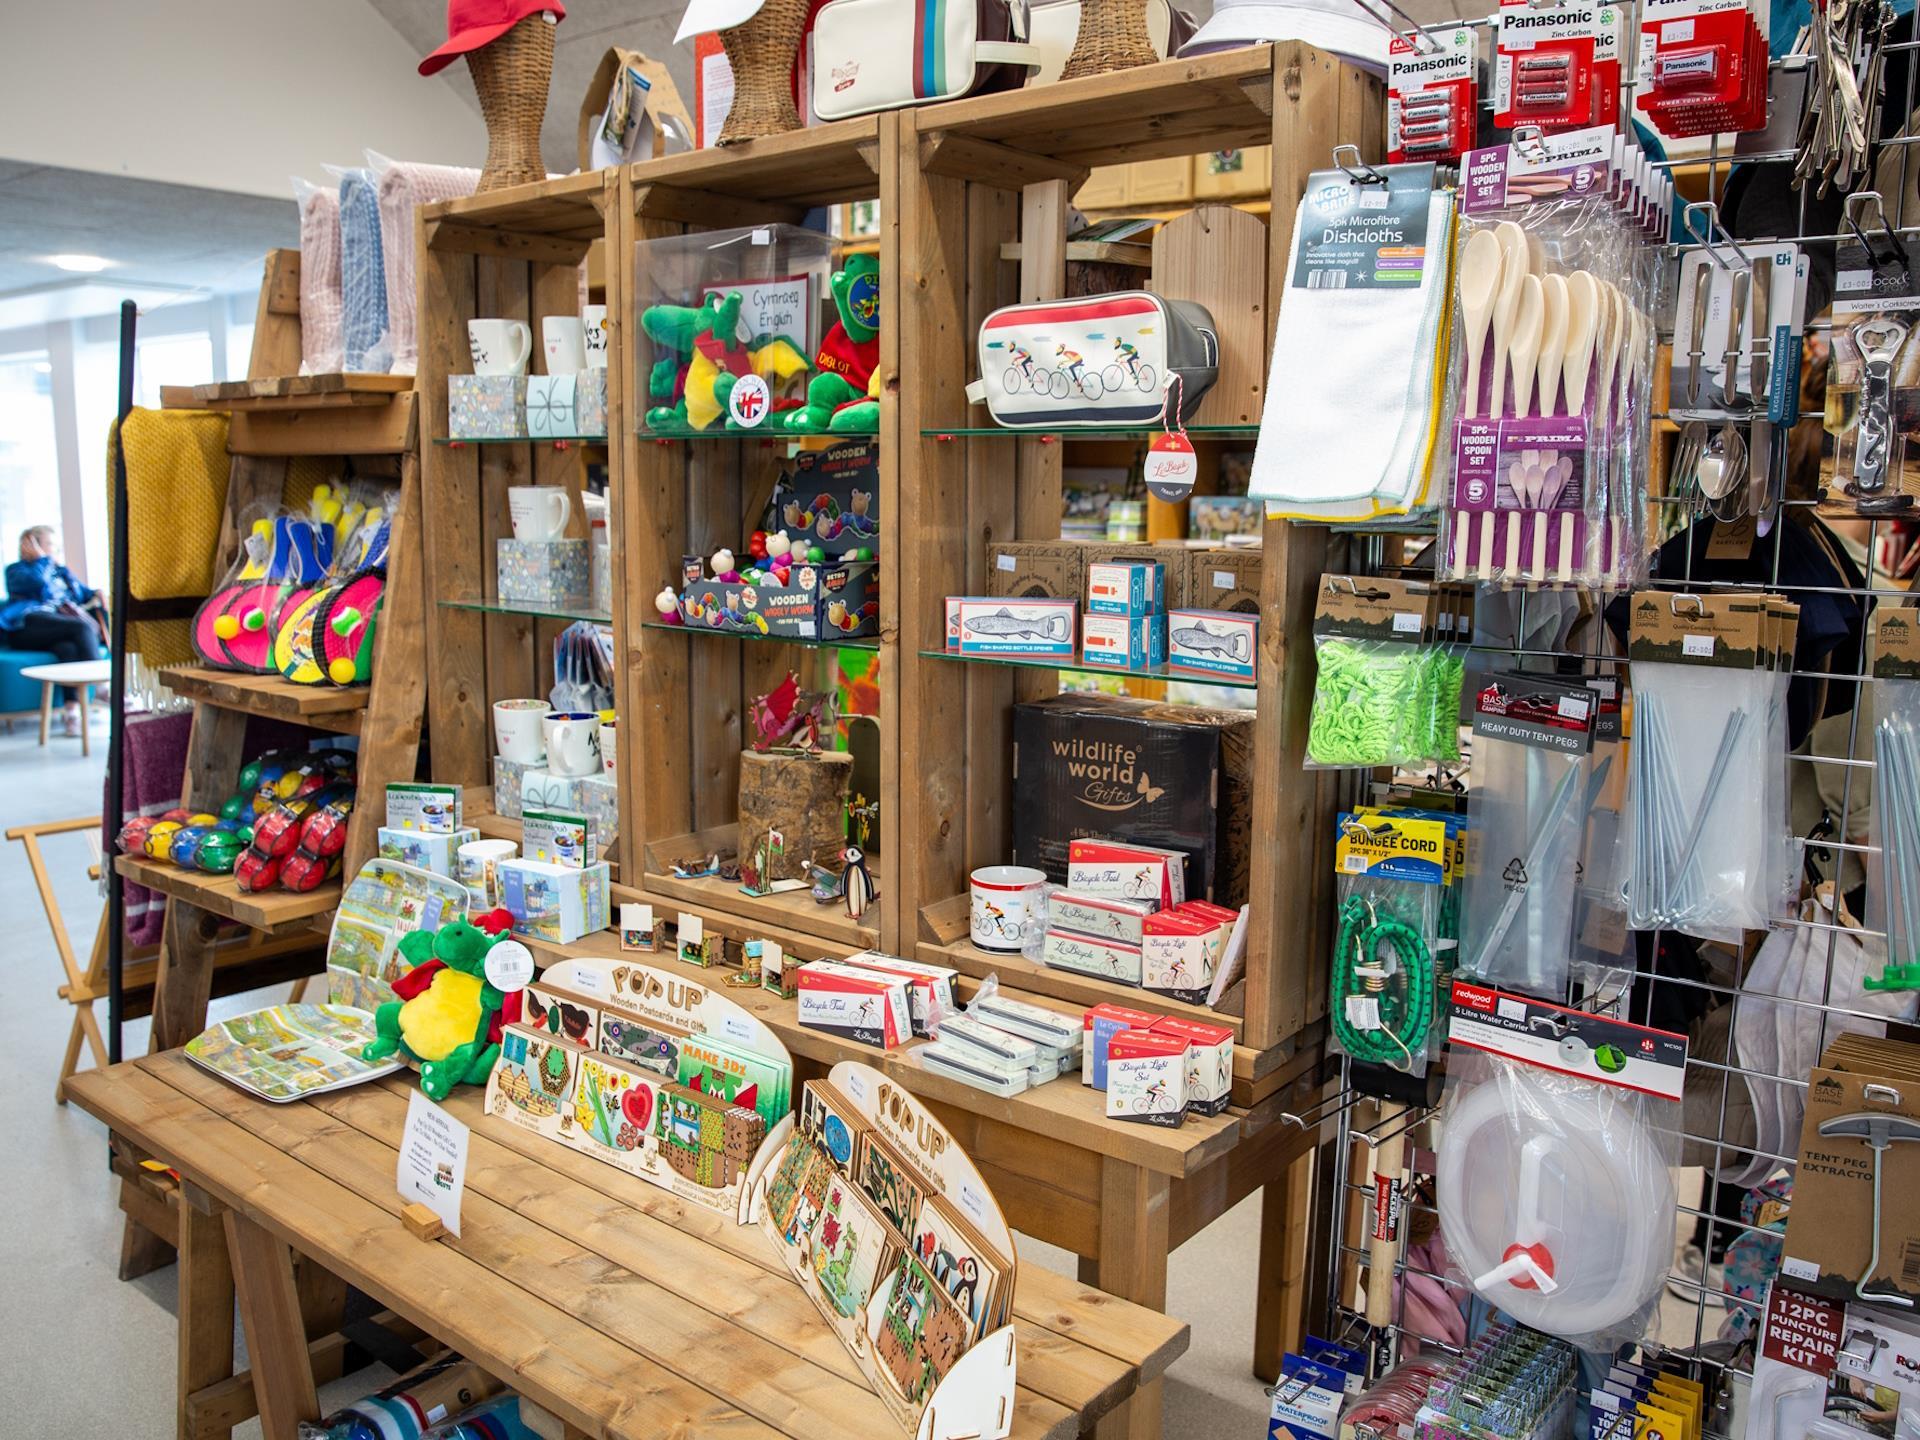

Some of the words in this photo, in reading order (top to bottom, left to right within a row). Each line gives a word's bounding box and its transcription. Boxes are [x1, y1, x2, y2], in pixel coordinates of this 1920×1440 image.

[1715, 2, 1742, 10] Carbon
[1503, 9, 1593, 29] Panasonic
[1567, 29, 1592, 37] Carbon
[1595, 51, 1614, 59] arbon
[1393, 53, 1467, 75] Panasonic
[1665, 59, 1707, 70] Panasonic
[1480, 152, 1497, 163] 5PC
[1546, 146, 1603, 163] PRIMA
[1470, 162, 1505, 175] WOODEN
[1472, 172, 1501, 186] SPOON
[1575, 170, 1590, 184] 5
[1309, 186, 1349, 204] MICRO
[1478, 186, 1493, 197] SET
[1349, 215, 1400, 226] Microfibre
[1323, 228, 1403, 244] Dishcloths
[1776, 253, 1791, 265] EH
[752, 289, 800, 309] Cymraeg
[1772, 373, 1781, 414] EXCELLENT
[1778, 330, 1787, 371] HOUSEWARE
[1783, 380, 1792, 421] EXCELLENT
[1789, 340, 1798, 380] HOUSEWARE
[1471, 425, 1488, 435] 5PC
[1462, 435, 1496, 445] WOODEN
[1524, 434, 1584, 443] PRIMA
[827, 446, 867, 460] WOODEN
[1464, 445, 1492, 455] SPOON
[1469, 456, 1486, 465] SET
[1468, 483, 1484, 497] 5
[769, 594, 809, 606] WOODEN
[764, 606, 789, 617] WIGGLY
[790, 605, 815, 616] WORM
[1636, 611, 1659, 620] BASE
[1880, 627, 1909, 637] BASE
[1481, 705, 1507, 715] CAMPING
[1481, 722, 1508, 735] HEAVY
[1509, 728, 1531, 740] DUTY
[1532, 732, 1554, 745] TENT
[1555, 737, 1579, 749] PEGS
[1052, 740, 1137, 765] wildlife
[1068, 761, 1135, 785] world
[1084, 781, 1133, 804] Gifts
[1350, 835, 1398, 849] BUNGEE
[1400, 838, 1437, 853] CORD
[1072, 870, 1100, 885] Bicycle
[667, 980, 703, 1012] UP
[802, 996, 828, 1012] Bicycle
[1456, 989, 1491, 1004] redwood
[609, 993, 638, 1010] Wooden
[639, 1001, 674, 1023] Postcards
[676, 1014, 689, 1027] and
[690, 1019, 708, 1034] Gifts
[1455, 1006, 1461, 1014] 5
[1461, 1007, 1479, 1019] Litre
[1480, 1013, 1502, 1025] Water
[1503, 1019, 1529, 1032] Carrier
[683, 1044, 719, 1067] MAKE
[1119, 1061, 1148, 1074] Bicycle
[1150, 1059, 1169, 1072] Light
[1814, 1086, 1845, 1099] BASE
[1812, 1096, 1842, 1106] CAMPING
[916, 1114, 945, 1161] UP
[895, 1135, 922, 1167] Postcards
[921, 1163, 933, 1176] and
[1805, 1151, 1842, 1164] TENT
[1843, 1158, 1868, 1169] PEG
[1803, 1162, 1874, 1181] EXTRACTO
[1388, 1179, 1399, 1229] BLACKSPUR
[1778, 1300, 1830, 1327] 12PC
[1771, 1313, 1838, 1343] PUNCTURE
[1770, 1325, 1836, 1357] REPAIR
[1782, 1344, 1817, 1367] KIT
[1286, 1384, 1331, 1402] WATPROOF
[1277, 1403, 1329, 1425] WATERPROOF
